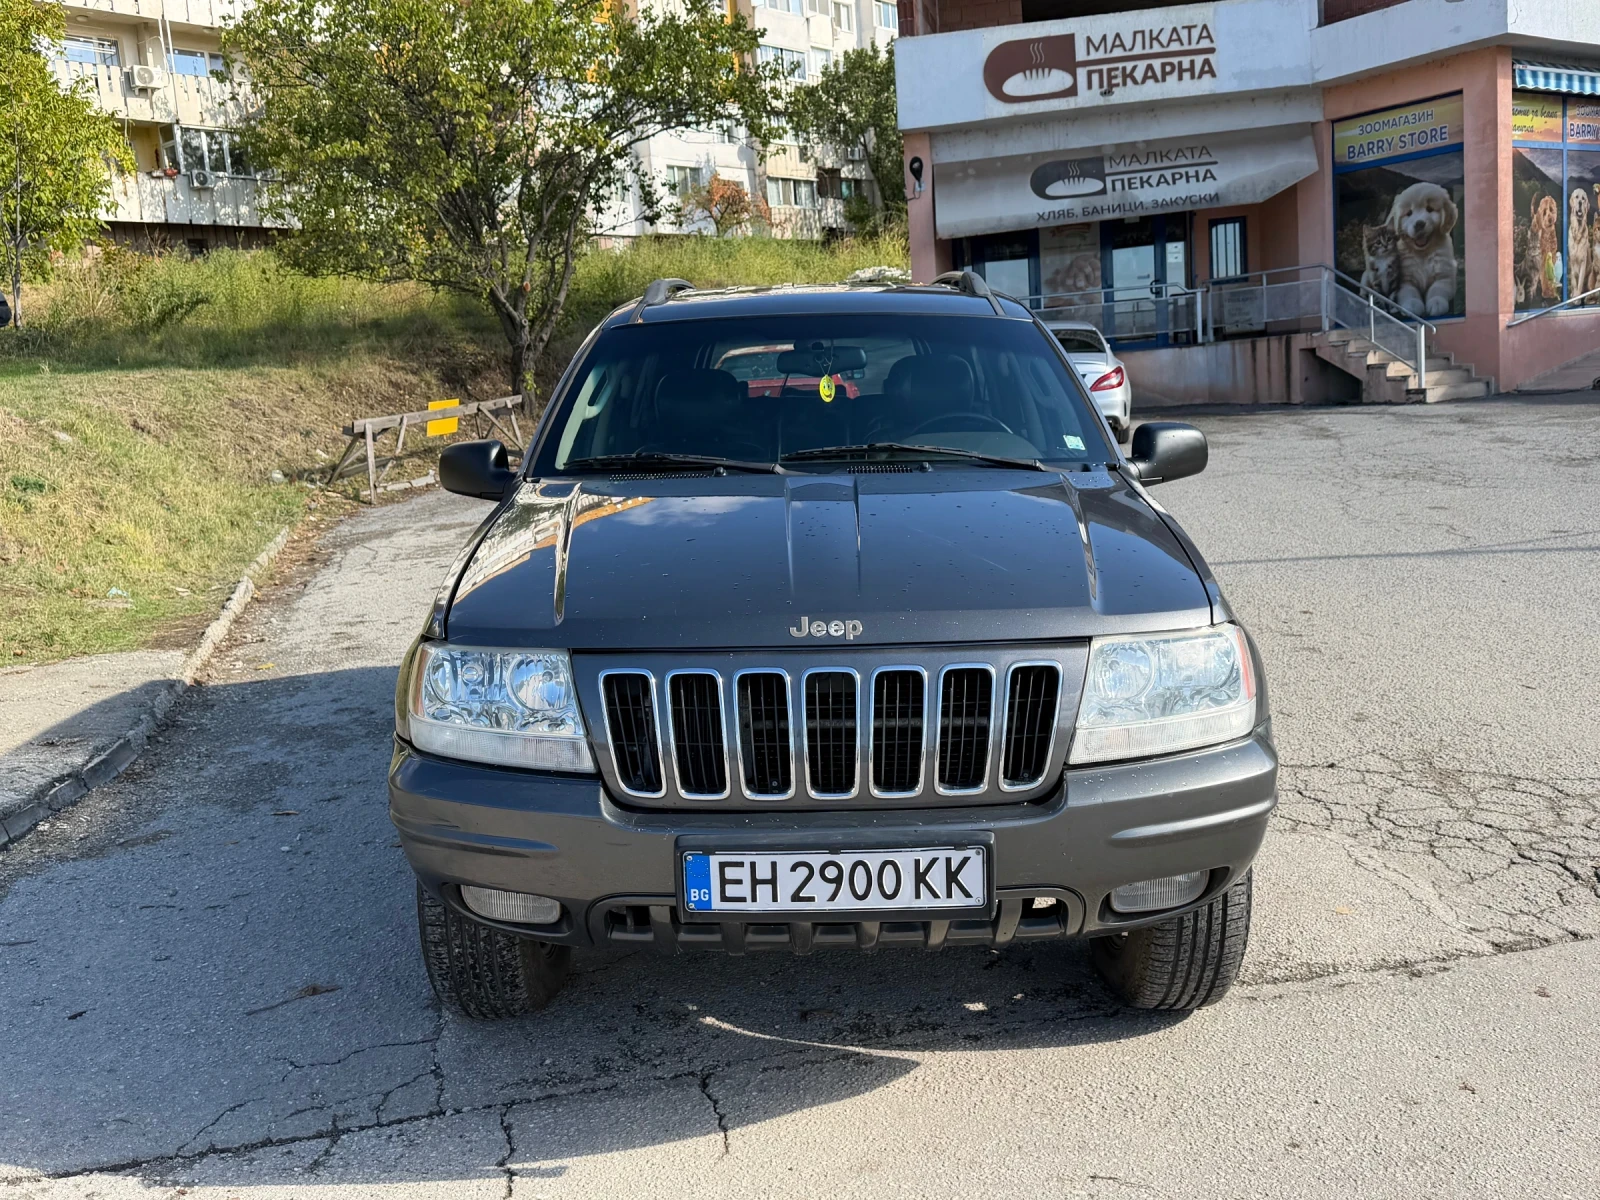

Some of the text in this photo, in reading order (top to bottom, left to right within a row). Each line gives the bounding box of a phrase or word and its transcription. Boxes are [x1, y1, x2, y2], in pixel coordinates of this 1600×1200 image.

[1086, 23, 1214, 56] МАЛКАТА
[1086, 58, 1217, 90] ПЕКАРНА
[1358, 109, 1434, 136] ЗООМАГАЗИН
[1569, 122, 1598, 139] BARRY
[1347, 125, 1448, 160] BARRY STORE
[1109, 145, 1213, 169] МАЛКАТА
[1111, 168, 1217, 192] ПЕКАРНА
[1151, 192, 1220, 209] ЗАКУСКИ
[789, 616, 863, 640] Jeep
[718, 856, 974, 903] EH 2900 KK
[690, 888, 709, 901] BG
